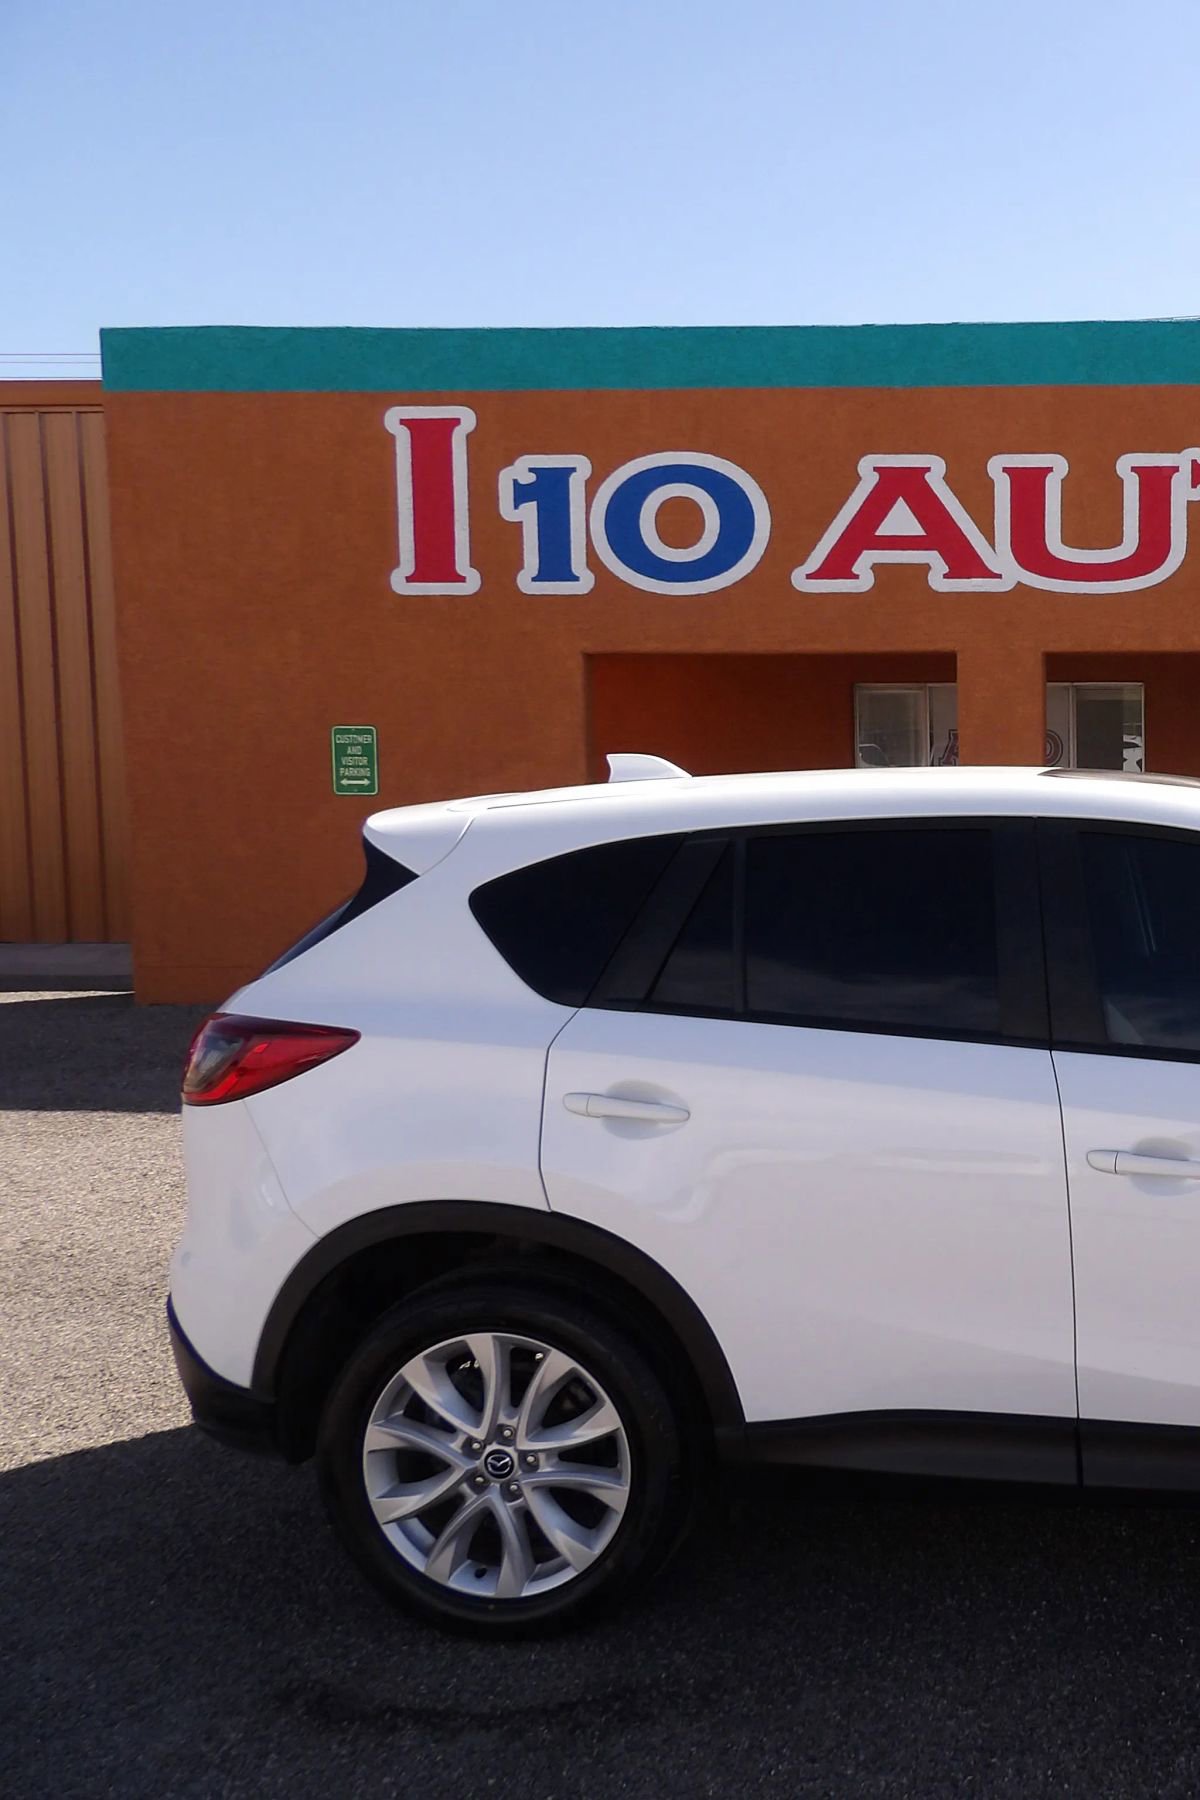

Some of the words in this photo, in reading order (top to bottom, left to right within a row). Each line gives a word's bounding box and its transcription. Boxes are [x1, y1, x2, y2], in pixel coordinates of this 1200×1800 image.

[336, 734, 372, 744] CUSTOMER
[346, 746, 362, 754] AND
[341, 756, 368, 766] VISITOR
[340, 768, 370, 776] PARKING
